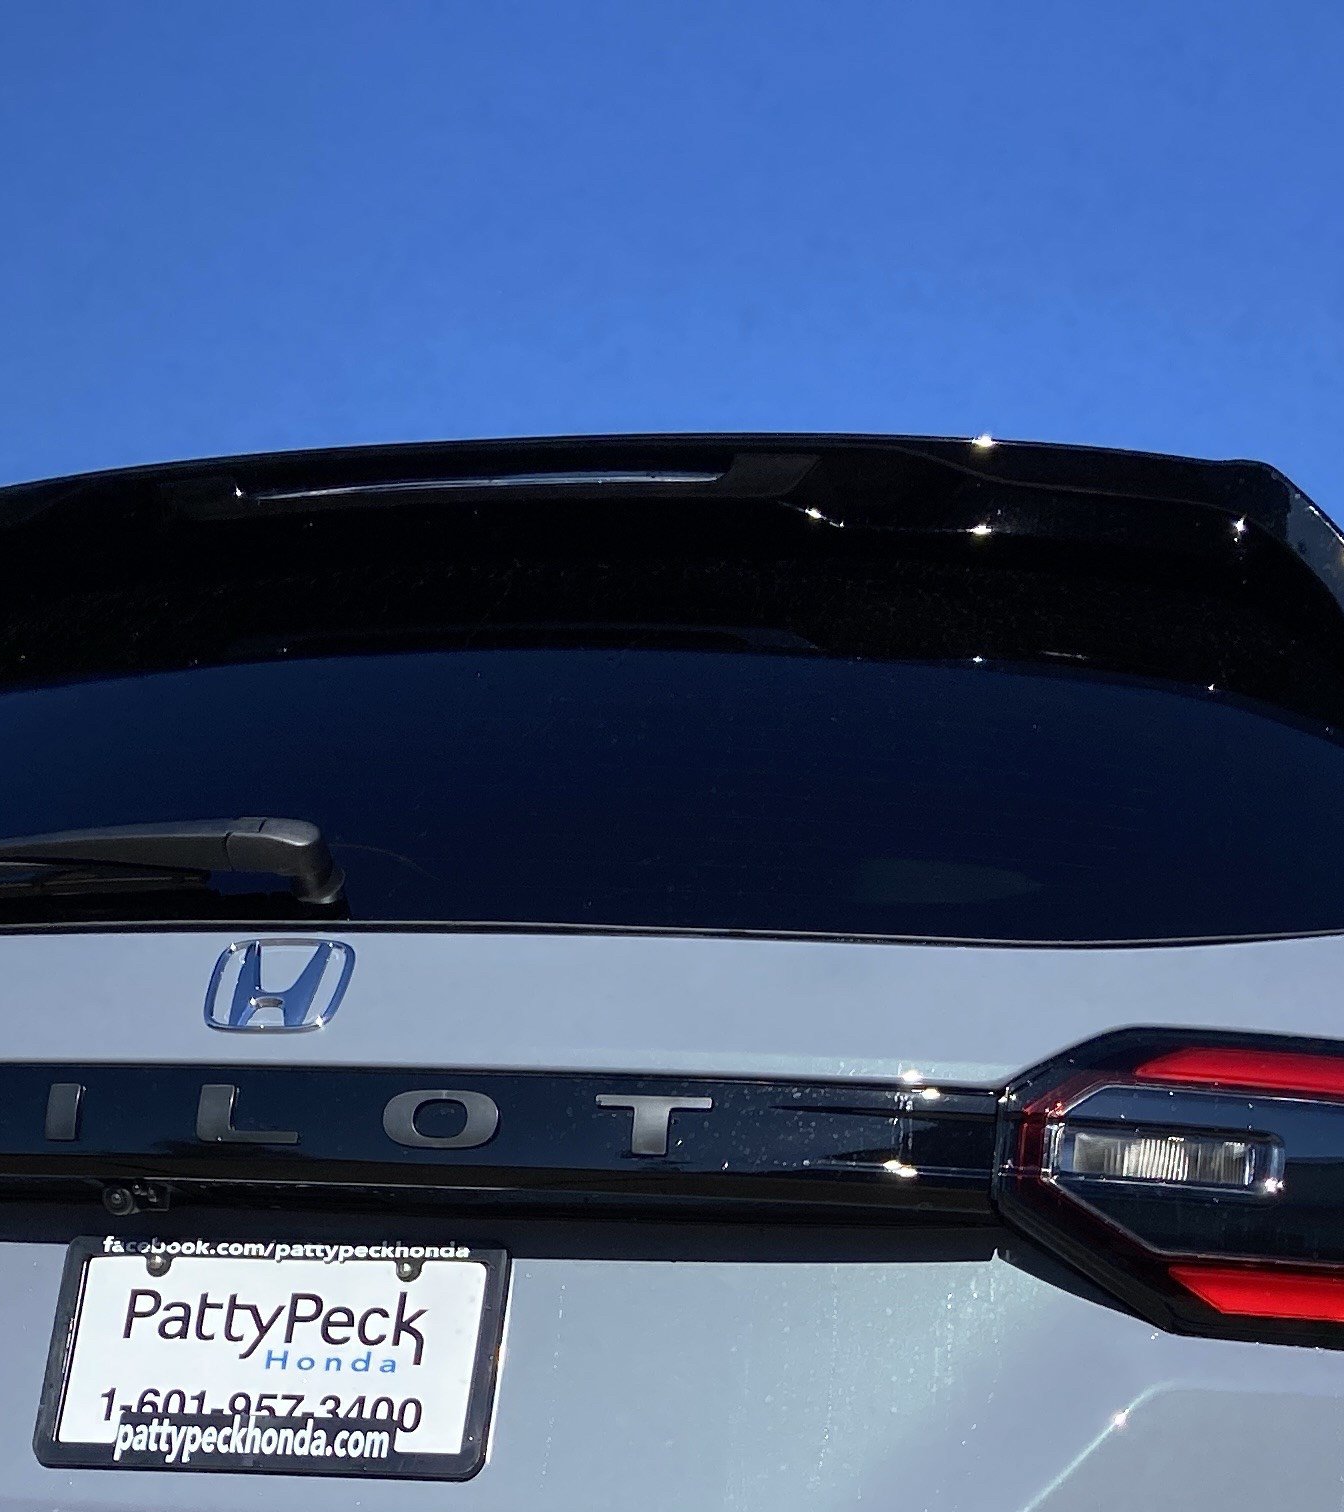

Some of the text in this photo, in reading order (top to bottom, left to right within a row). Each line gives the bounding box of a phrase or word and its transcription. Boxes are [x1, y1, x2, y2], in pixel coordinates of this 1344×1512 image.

[122, 1288, 430, 1367] PattyPeck
[264, 1350, 397, 1375] Honda
[100, 1387, 423, 1433] 1-601-957-3400
[112, 1413, 392, 1464] pattypeckhonda.com
